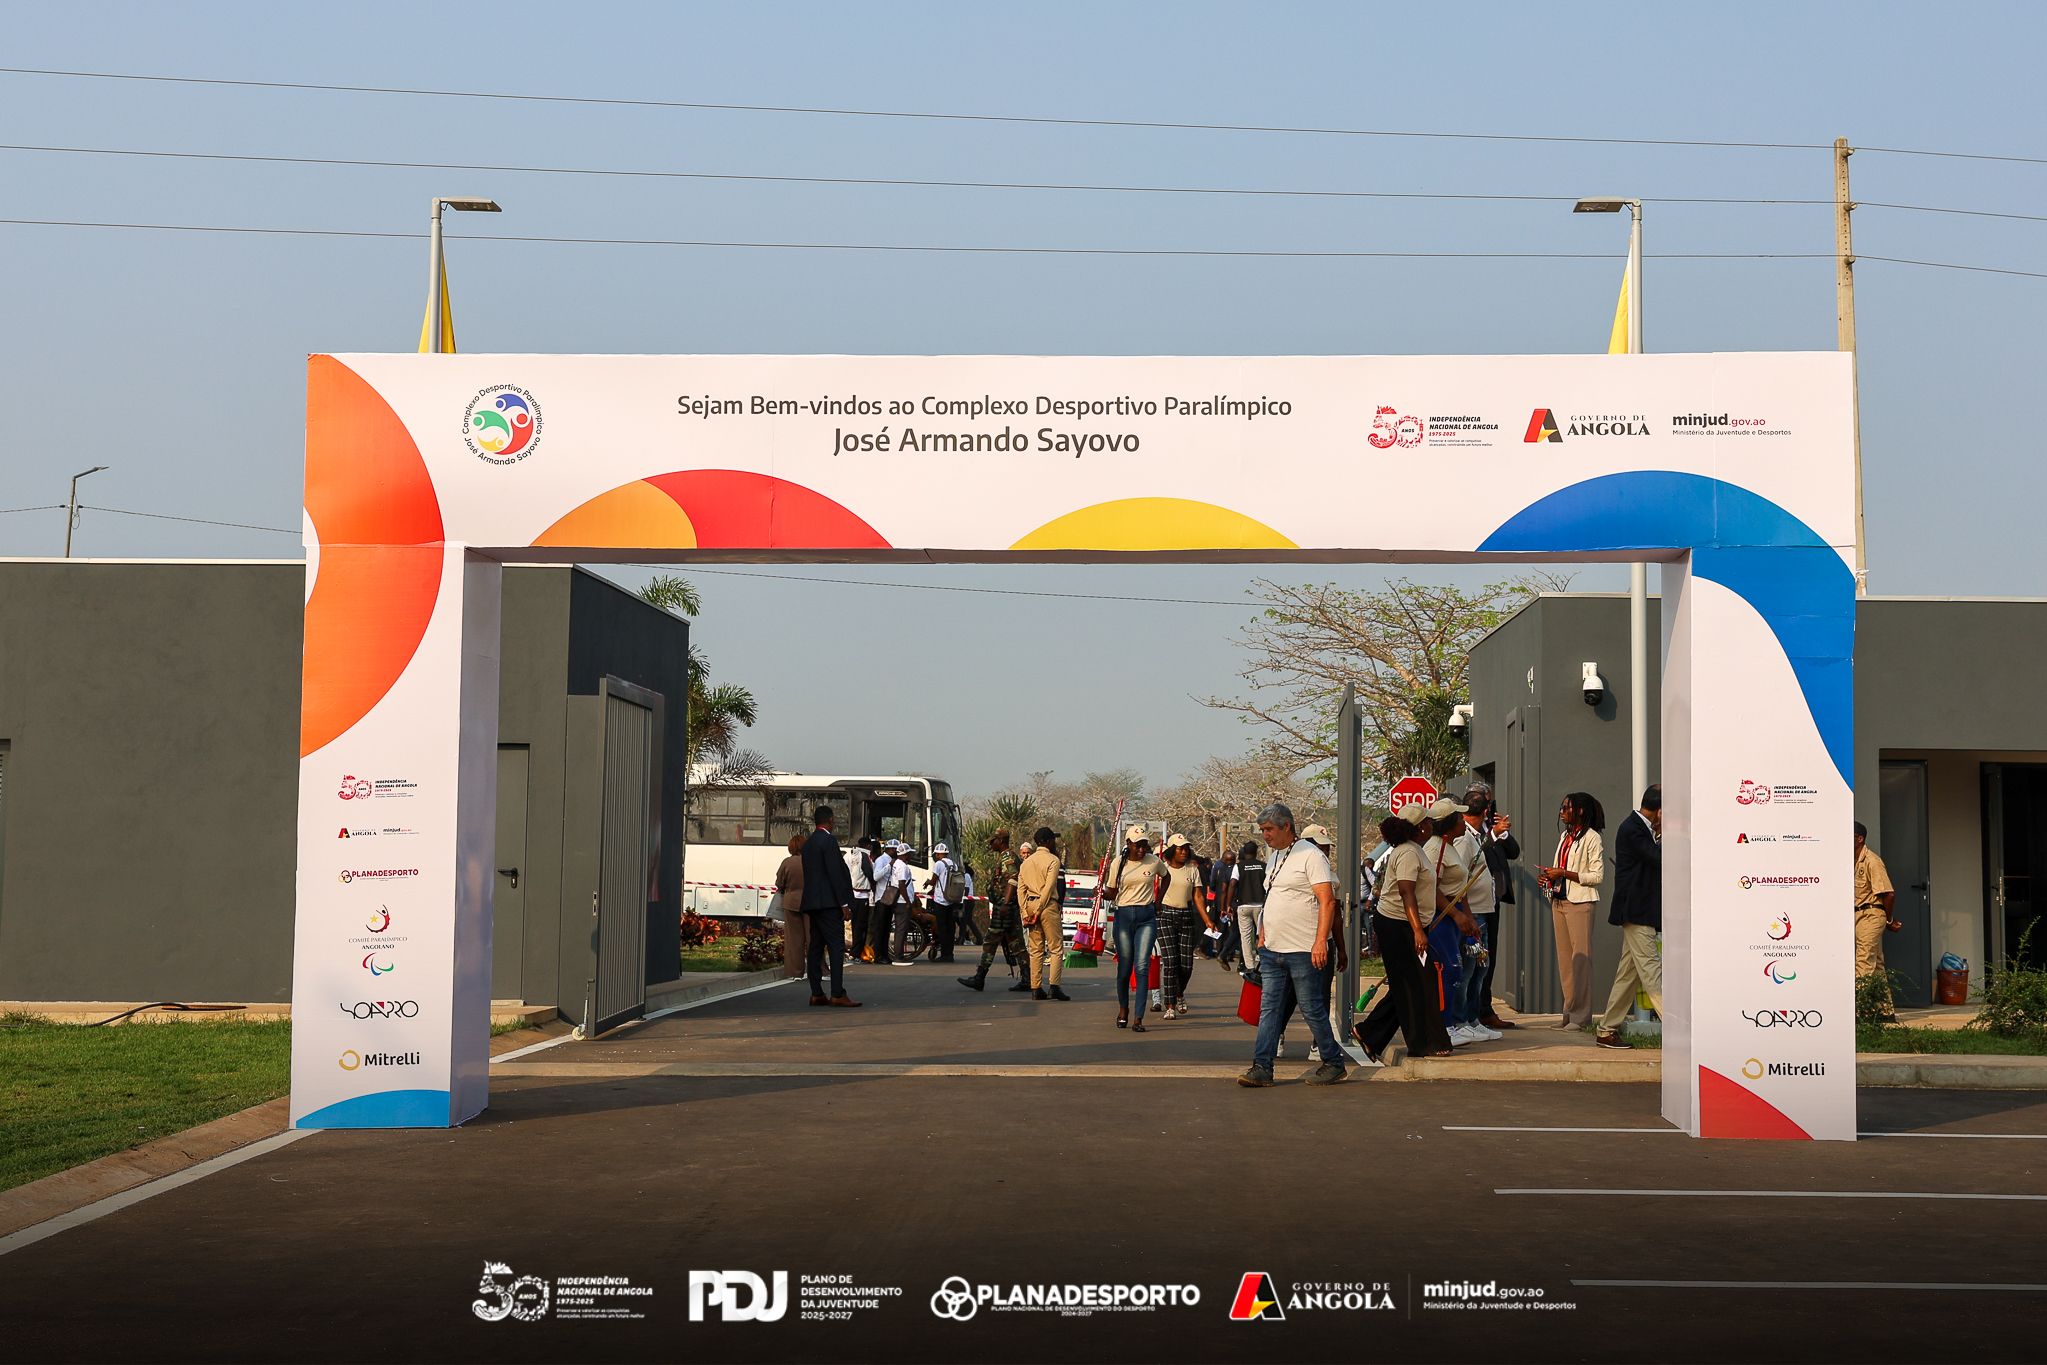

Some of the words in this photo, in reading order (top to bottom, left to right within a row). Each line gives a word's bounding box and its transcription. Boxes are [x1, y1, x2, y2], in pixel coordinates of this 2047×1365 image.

[462, 395, 480, 434] Complexo
[479, 383, 522, 397] Desportivo
[677, 395, 743, 420] Sejam
[750, 395, 882, 415] Bem-vindos
[888, 400, 915, 415] ao
[922, 395, 1029, 420] Complexo
[1036, 395, 1157, 420] Desportivo
[1164, 395, 1292, 420] Paralímpico
[1672, 413, 1766, 428] minjud.gov.ao
[1567, 422, 1651, 436] ANGOLA
[1757, 429, 1792, 437] Desportos
[833, 426, 890, 457] José
[899, 426, 1029, 452] Armando
[1037, 427, 1140, 458] Sayovo
[464, 437, 479, 454] José
[478, 452, 516, 465] Armando
[516, 437, 541, 461] Sayovo
[1392, 792, 1436, 809] STOP
[351, 869, 419, 877] PLANADESPORTO
[1751, 876, 1820, 884] PLANADESPORTO
[365, 1052, 420, 1066] Mitrelli
[1768, 1062, 1825, 1076] Mitrelli
